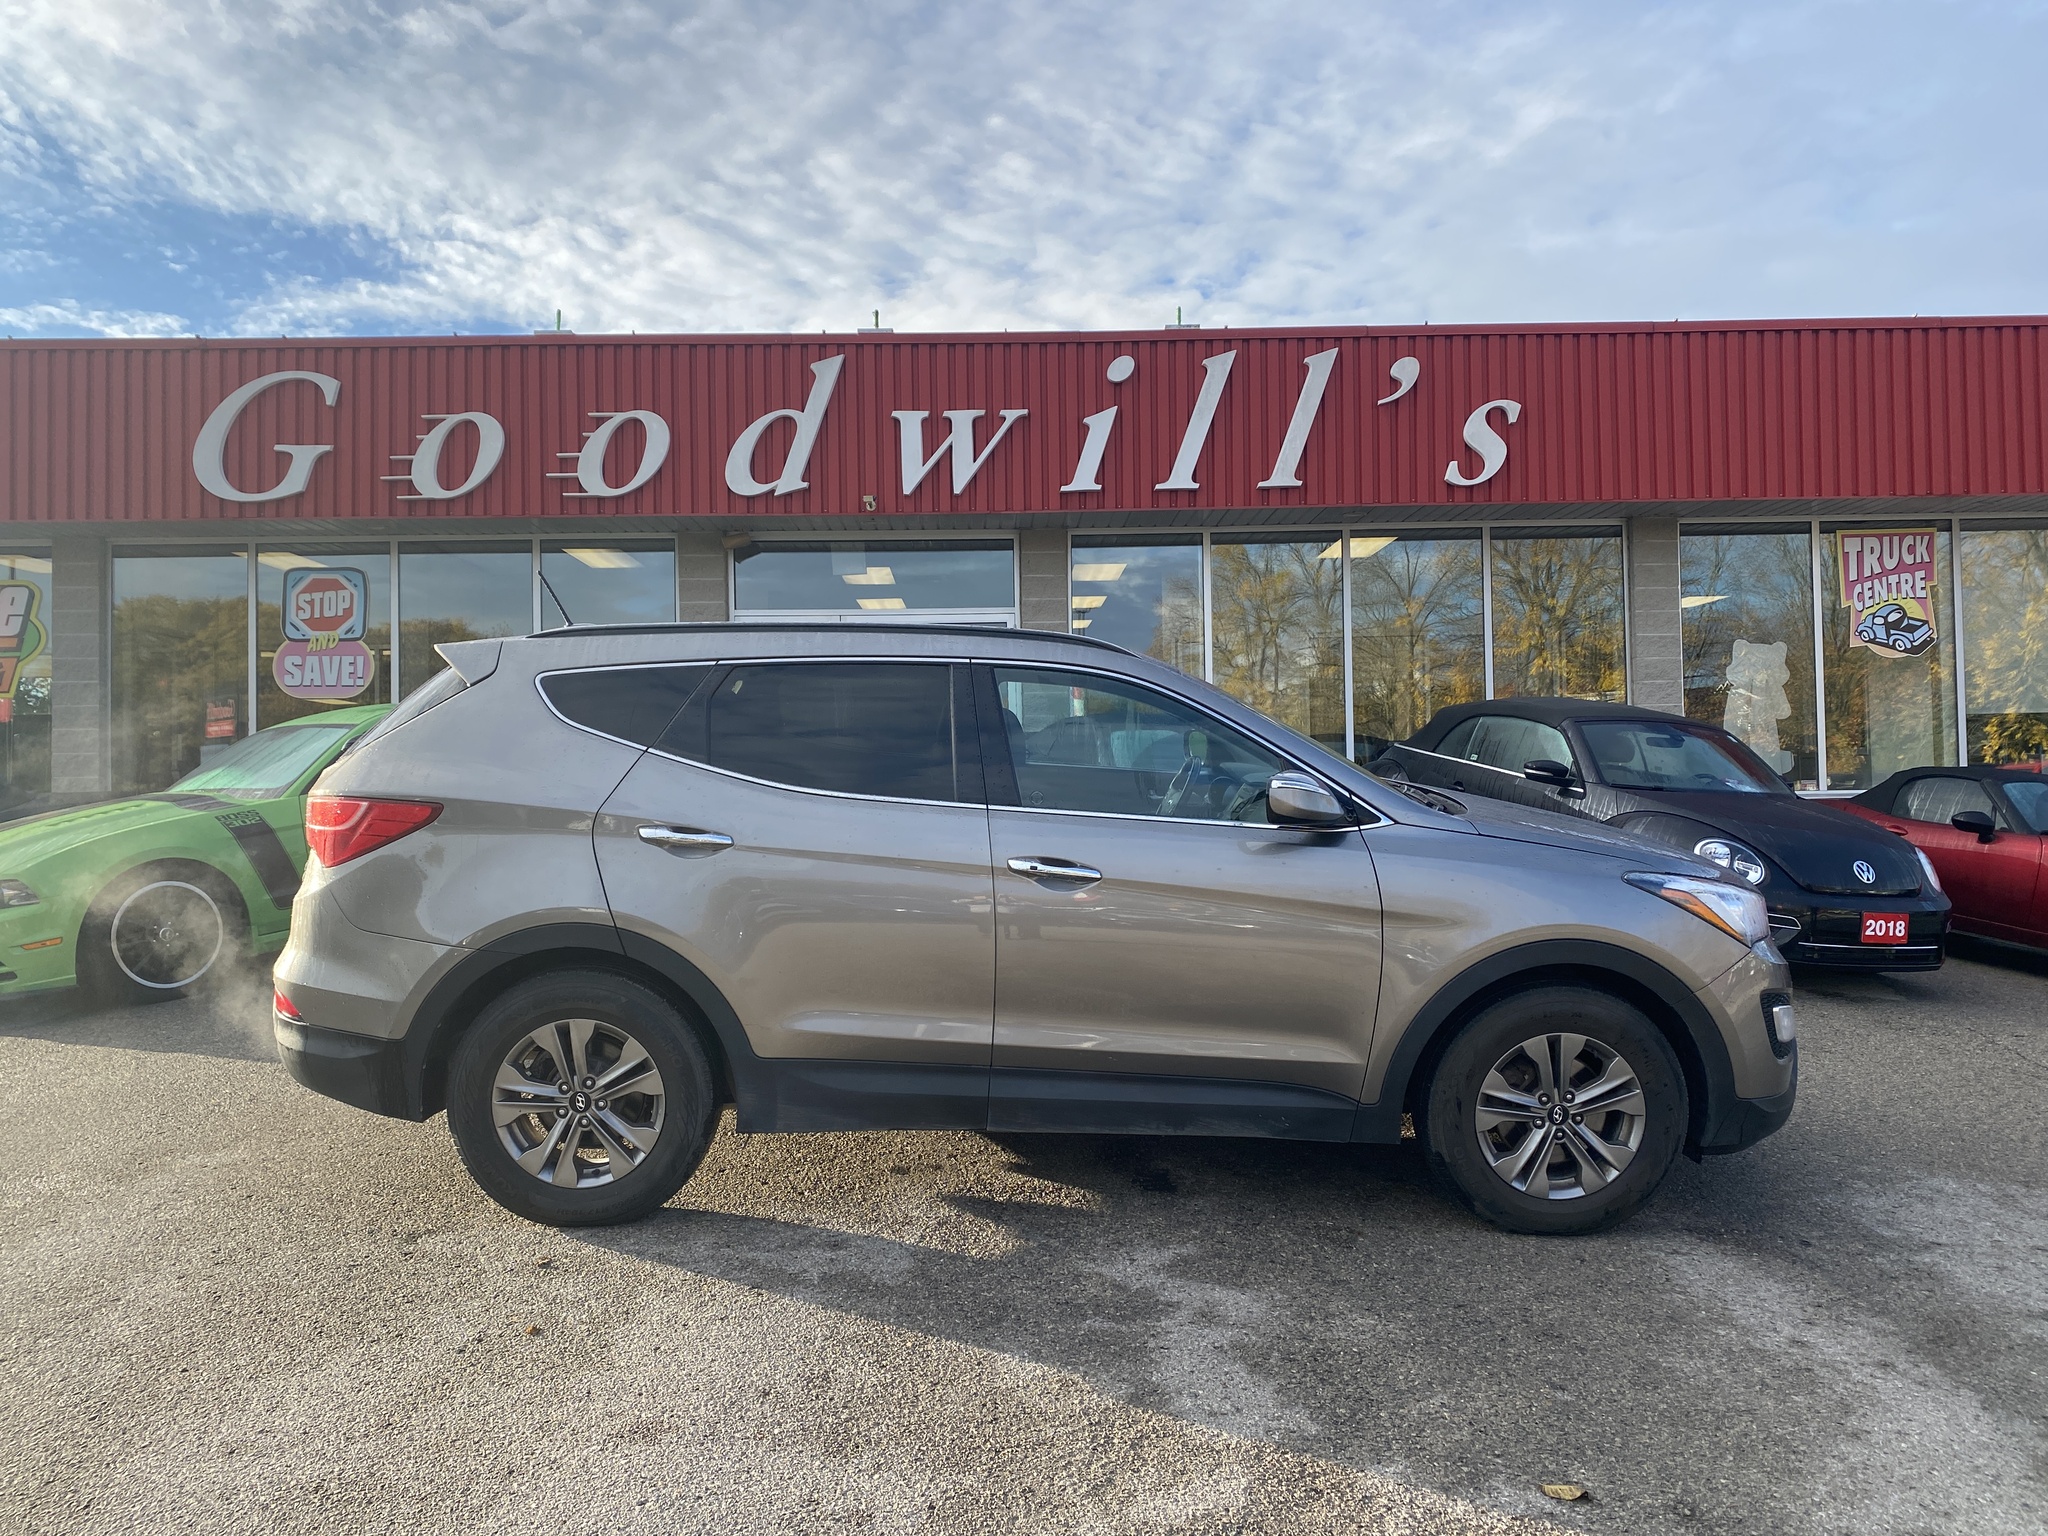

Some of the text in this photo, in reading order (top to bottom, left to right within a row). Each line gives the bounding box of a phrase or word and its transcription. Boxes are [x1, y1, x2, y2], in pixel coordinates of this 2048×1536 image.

[192, 347, 1522, 502] Goodwill's
[1843, 534, 1931, 582] TRUCK
[297, 590, 351, 620] STOP
[1853, 570, 1927, 612] CENTRE
[307, 632, 339, 652] AND
[284, 655, 365, 687] SAVE!
[214, 809, 260, 821] BOSS
[223, 816, 263, 828] 302
[1864, 919, 1906, 937] 2018
